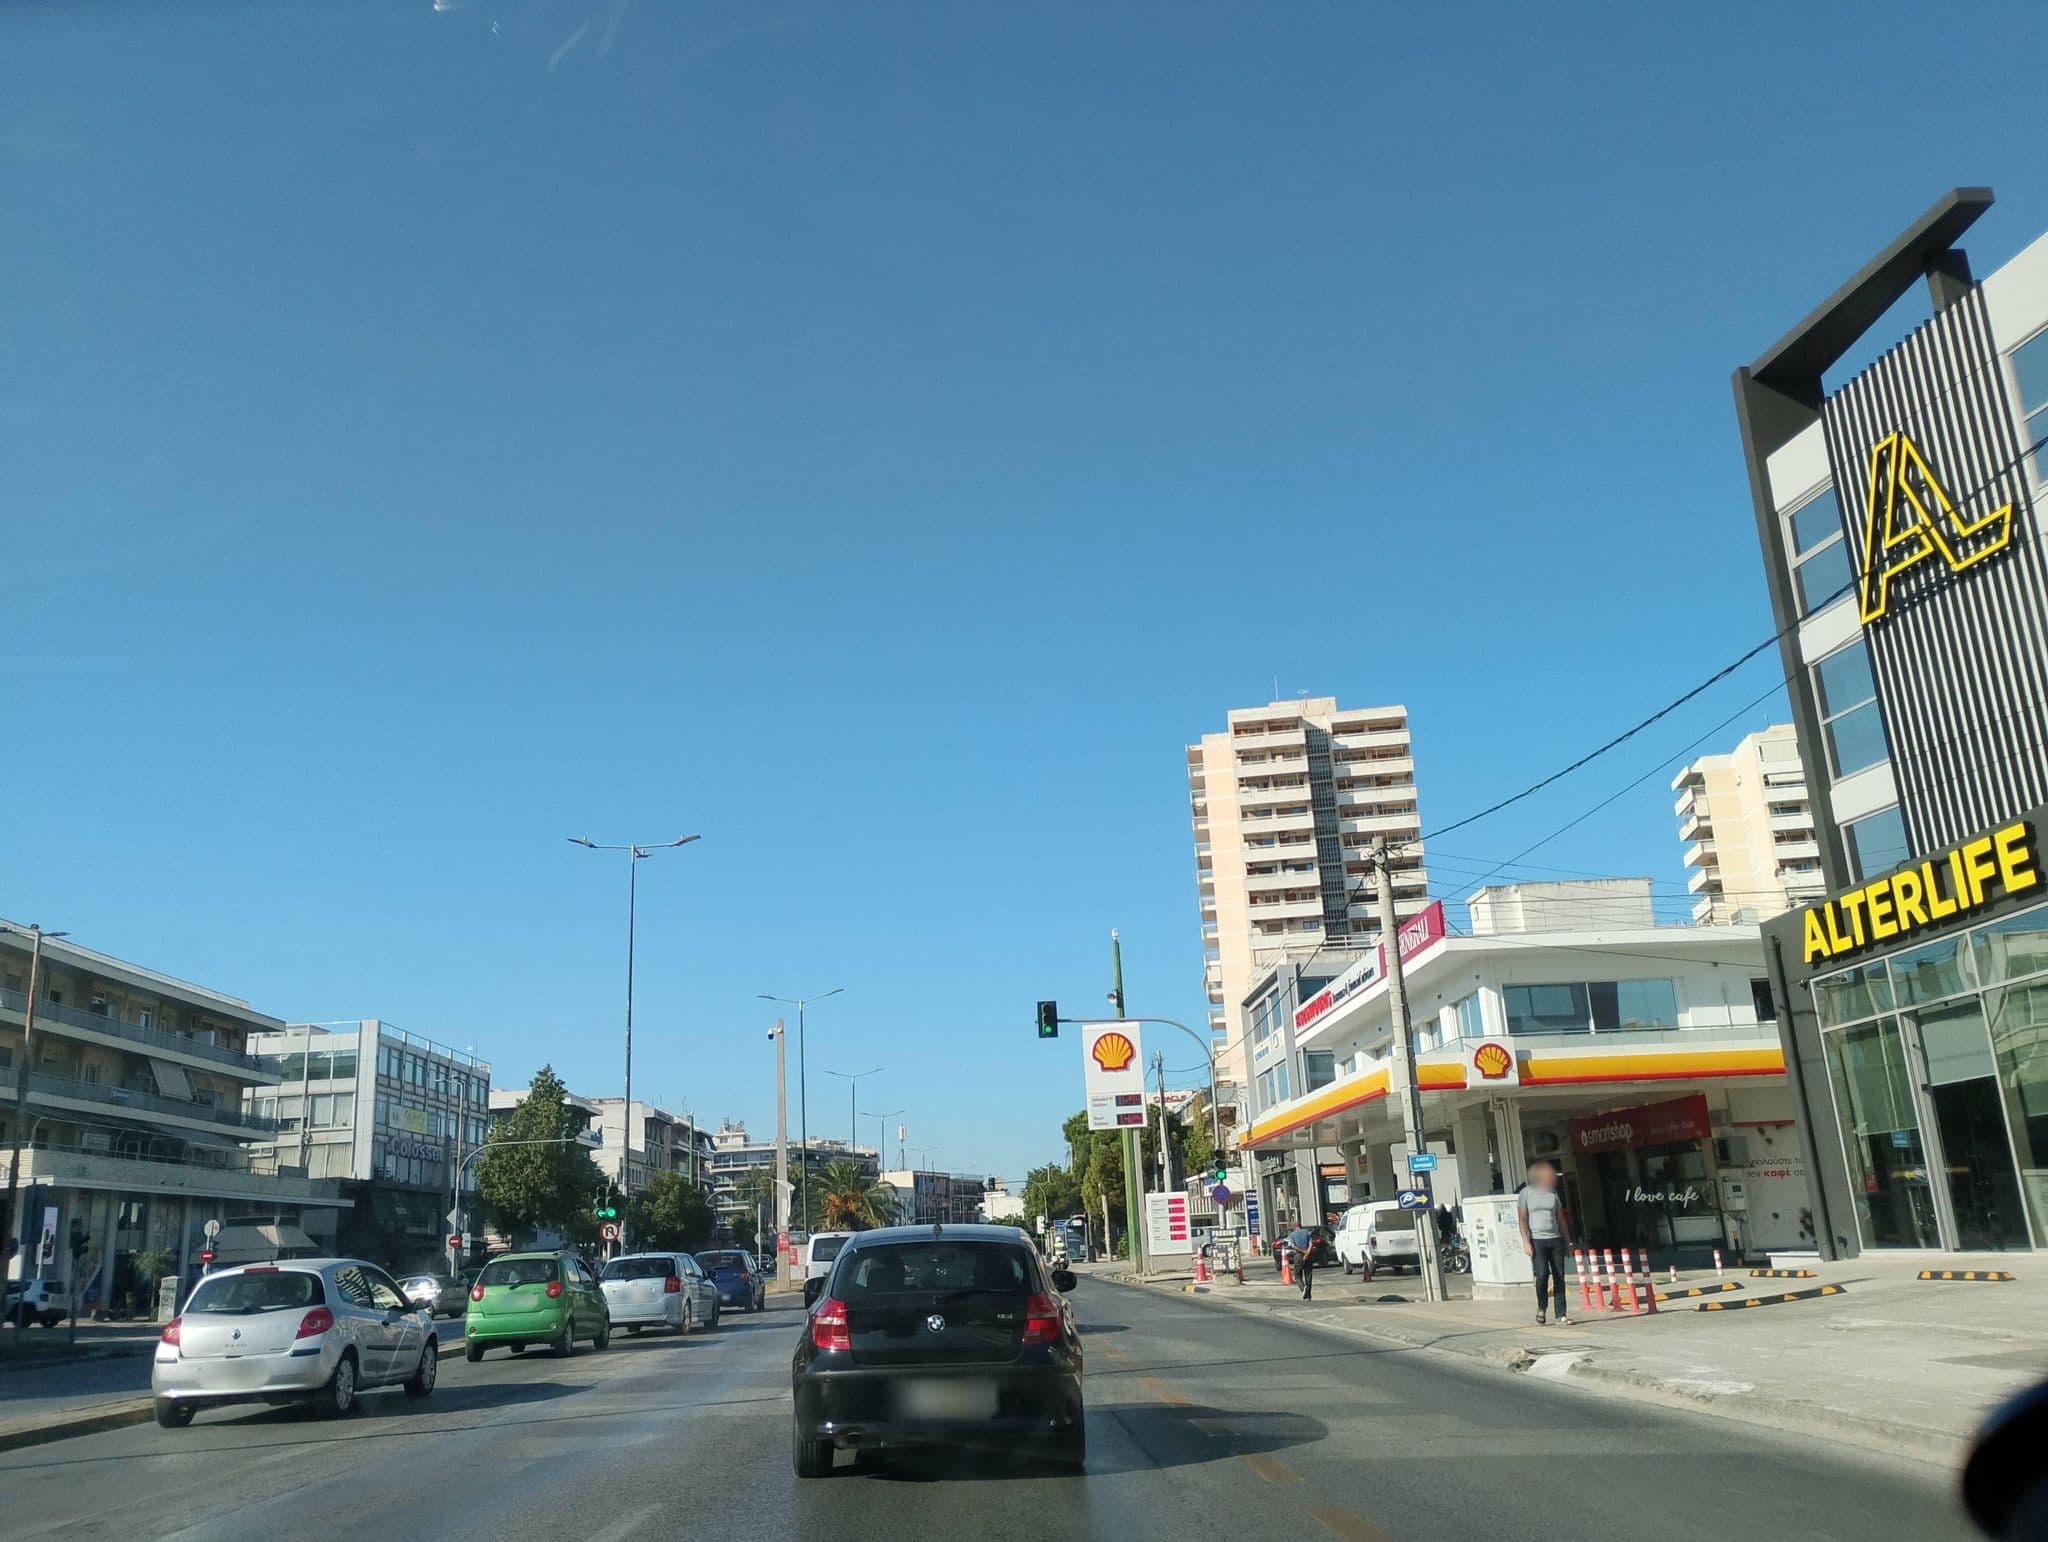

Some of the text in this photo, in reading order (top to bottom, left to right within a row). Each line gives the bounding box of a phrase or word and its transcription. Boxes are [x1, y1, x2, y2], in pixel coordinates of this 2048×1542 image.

[1803, 822, 2037, 963] ALTERLIFE
[1398, 914, 1430, 956] ENERALI
[1587, 1121, 1633, 1144] smartshop
[1763, 1168, 1791, 1179] καφέ
[1625, 1186, 1700, 1209] I love cafe
